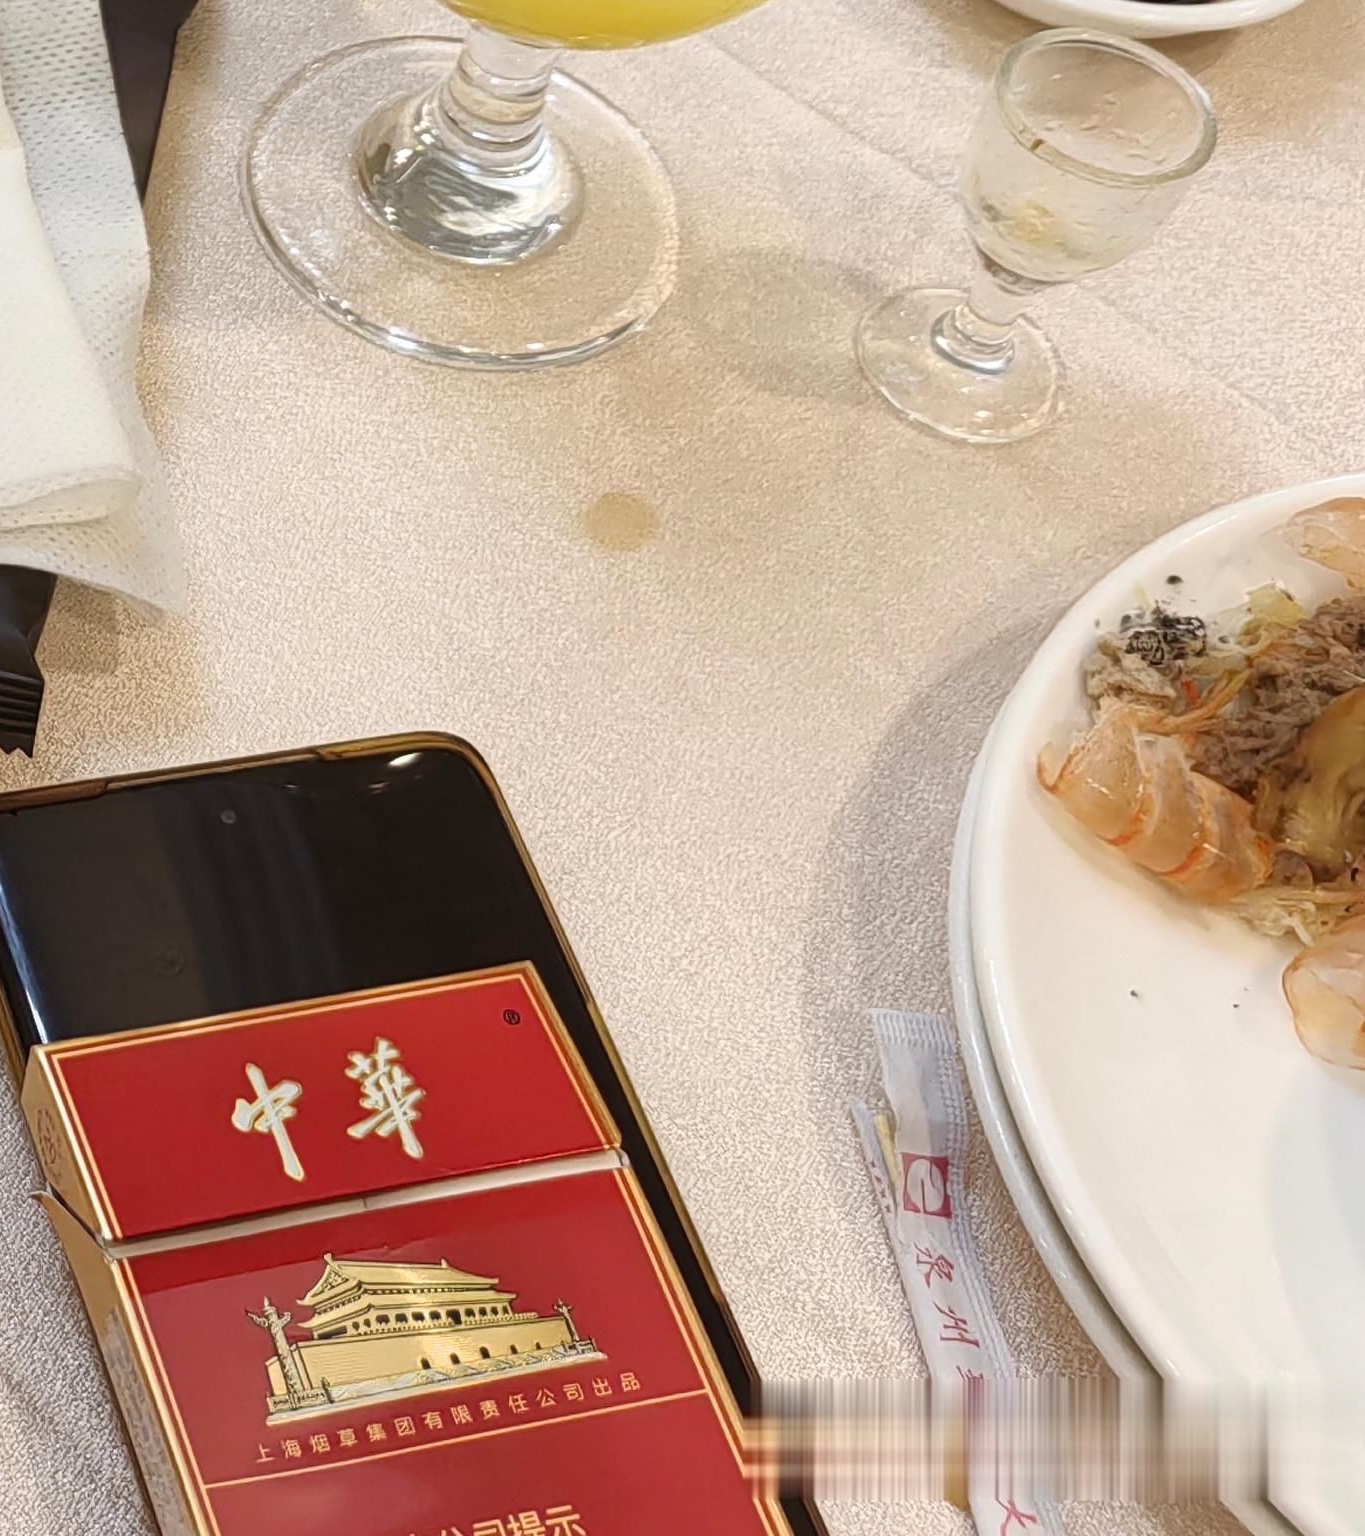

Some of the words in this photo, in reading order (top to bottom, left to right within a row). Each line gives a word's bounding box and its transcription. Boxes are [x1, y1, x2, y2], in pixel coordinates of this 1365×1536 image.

[255, 1371, 642, 1464] 上海烟草集团有限责任公司出品
